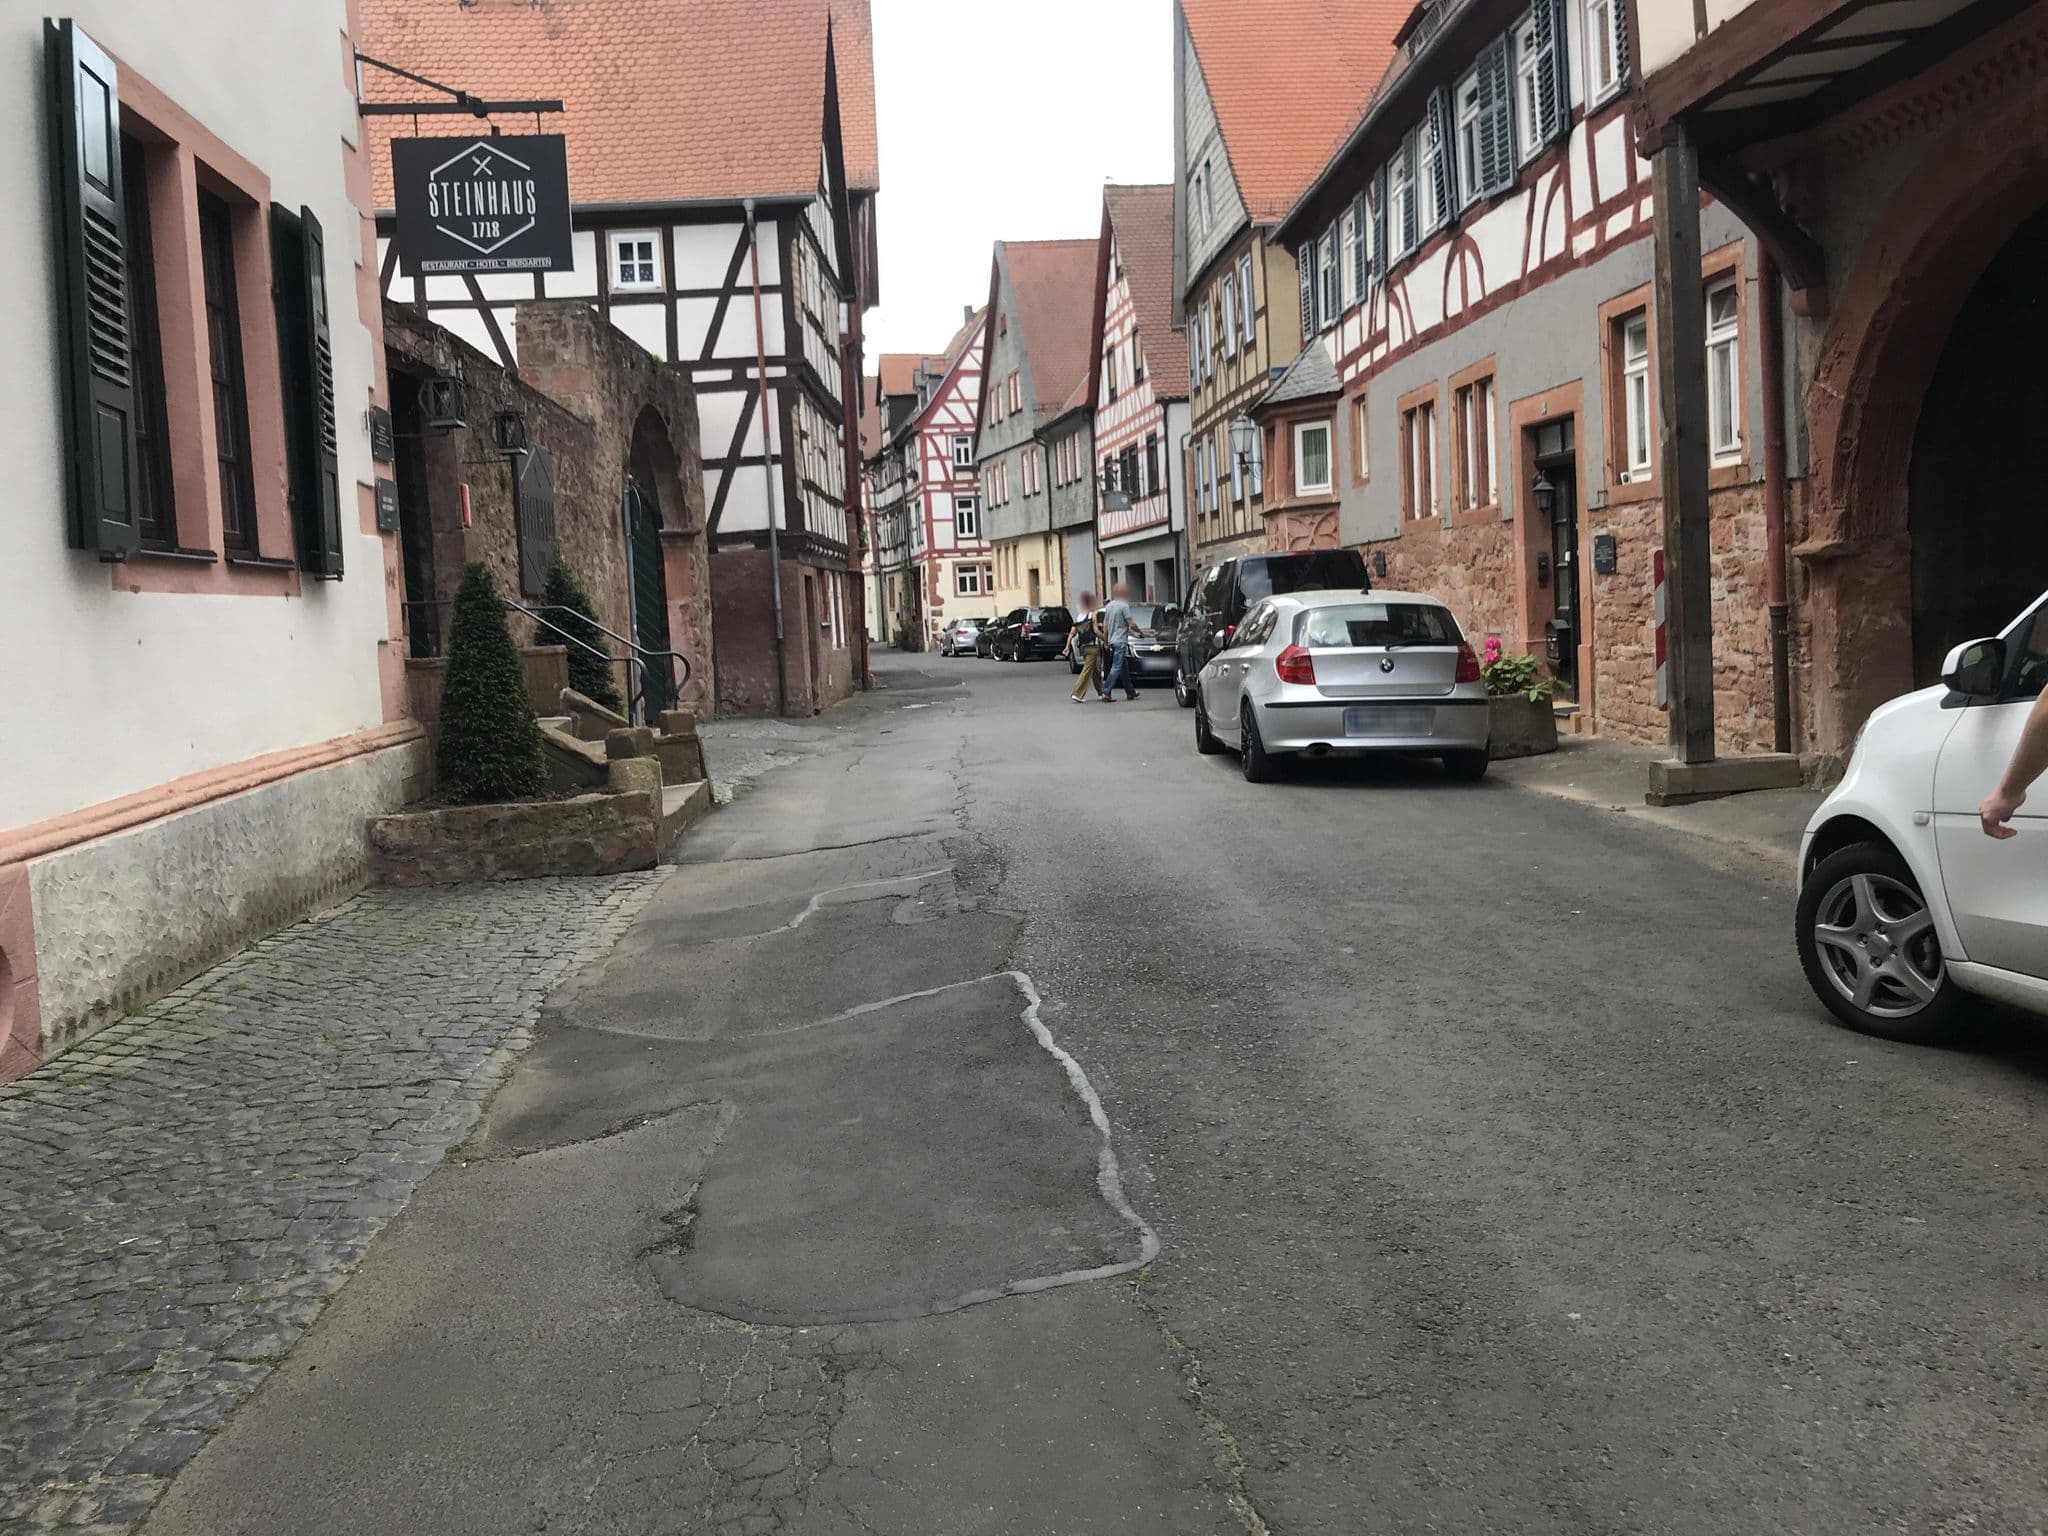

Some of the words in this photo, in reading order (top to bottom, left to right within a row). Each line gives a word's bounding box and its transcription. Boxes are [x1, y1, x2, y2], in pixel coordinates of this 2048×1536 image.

[428, 180, 536, 217] STEINHAUS
[472, 221, 500, 238] 1718
[422, 261, 468, 271] RESTAURANT
[476, 259, 499, 269] HOTEL
[507, 257, 551, 268] BIERGARTEN
